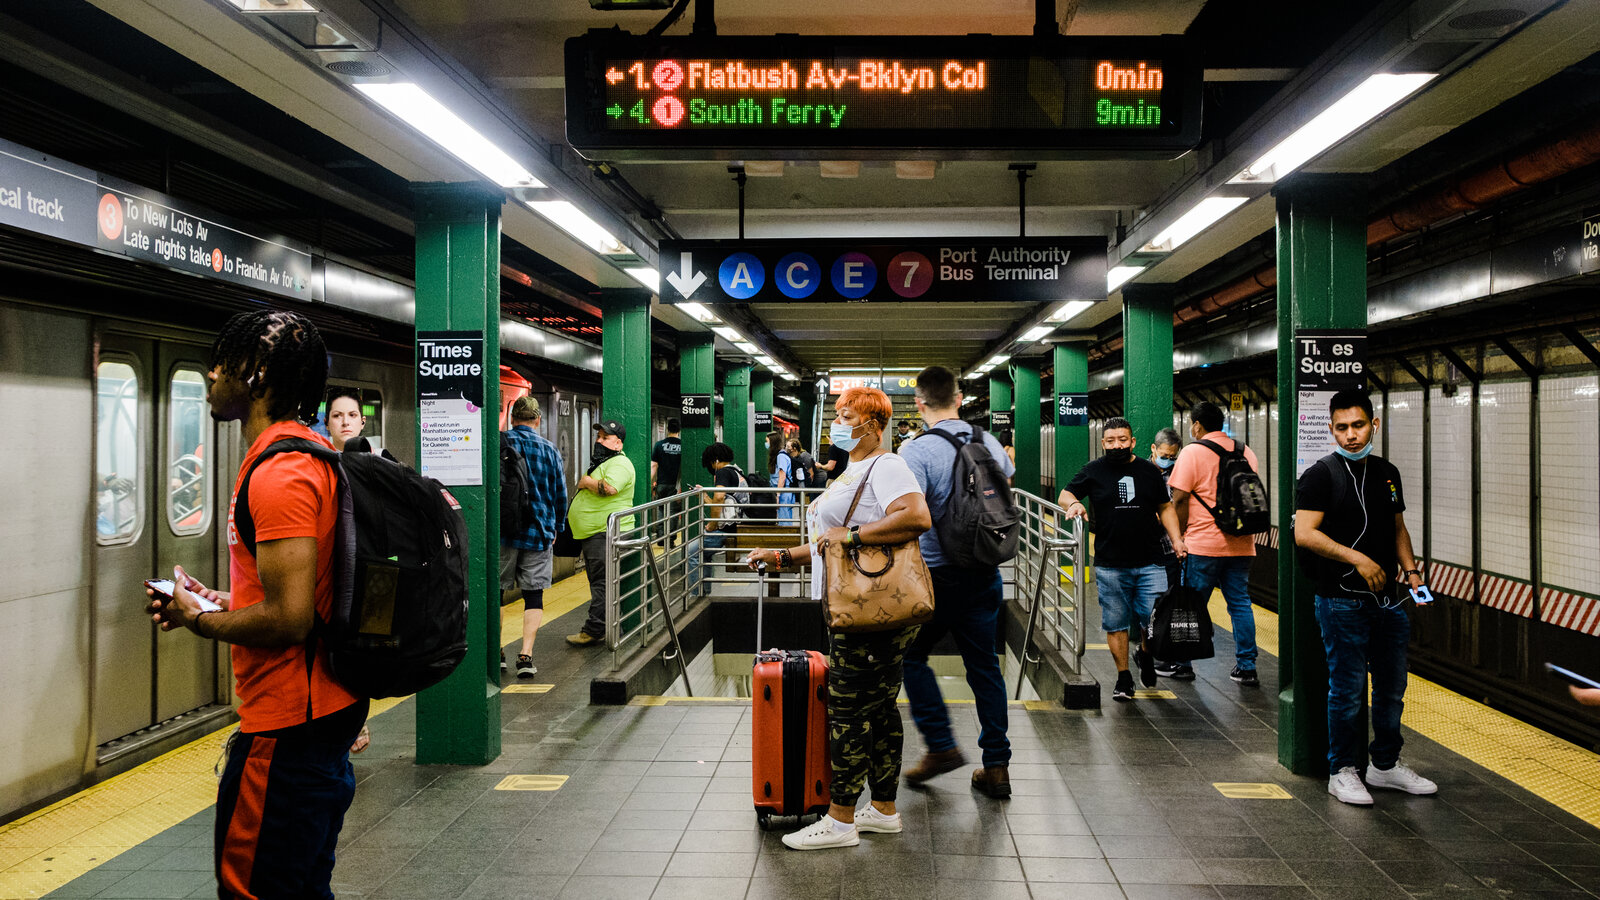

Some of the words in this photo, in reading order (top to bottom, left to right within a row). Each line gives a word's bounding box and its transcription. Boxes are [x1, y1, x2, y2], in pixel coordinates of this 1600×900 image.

[628, 62, 650, 89] 1.
[688, 62, 797, 89] Flatbush
[805, 61, 935, 93] Av-Bklyn
[942, 61, 986, 90] Col
[1097, 62, 1163, 89] 0min
[630, 98, 650, 124] 4.
[690, 98, 762, 124] South
[772, 98, 847, 128] Ferry
[1097, 99, 1161, 124] 9min
[27, 191, 64, 222] track
[124, 197, 139, 220] To
[143, 204, 168, 229] New
[171, 212, 193, 237] Lots
[195, 221, 208, 242] Av
[123, 225, 150, 251] Late
[154, 235, 186, 261] nights
[189, 244, 212, 268] take
[224, 254, 233, 273] to
[236, 257, 267, 282] Franklin
[270, 266, 280, 285] Av
[282, 270, 294, 289] for
[940, 248, 977, 264] Port
[988, 247, 1071, 265] Authority
[1583, 241, 1598, 260] via
[730, 262, 754, 289] A
[786, 262, 810, 289] C
[844, 262, 864, 289] E
[900, 261, 920, 288] 7
[940, 265, 974, 281] Bus
[984, 264, 1059, 280] Terminal
[419, 342, 473, 358] Times
[1301, 340, 1353, 356] Ties
[419, 360, 481, 380] Square
[1301, 357, 1363, 376] Square
[682, 398, 694, 406] 42
[682, 406, 709, 414] Street
[1059, 397, 1072, 406] 42
[1059, 406, 1087, 415] Street
